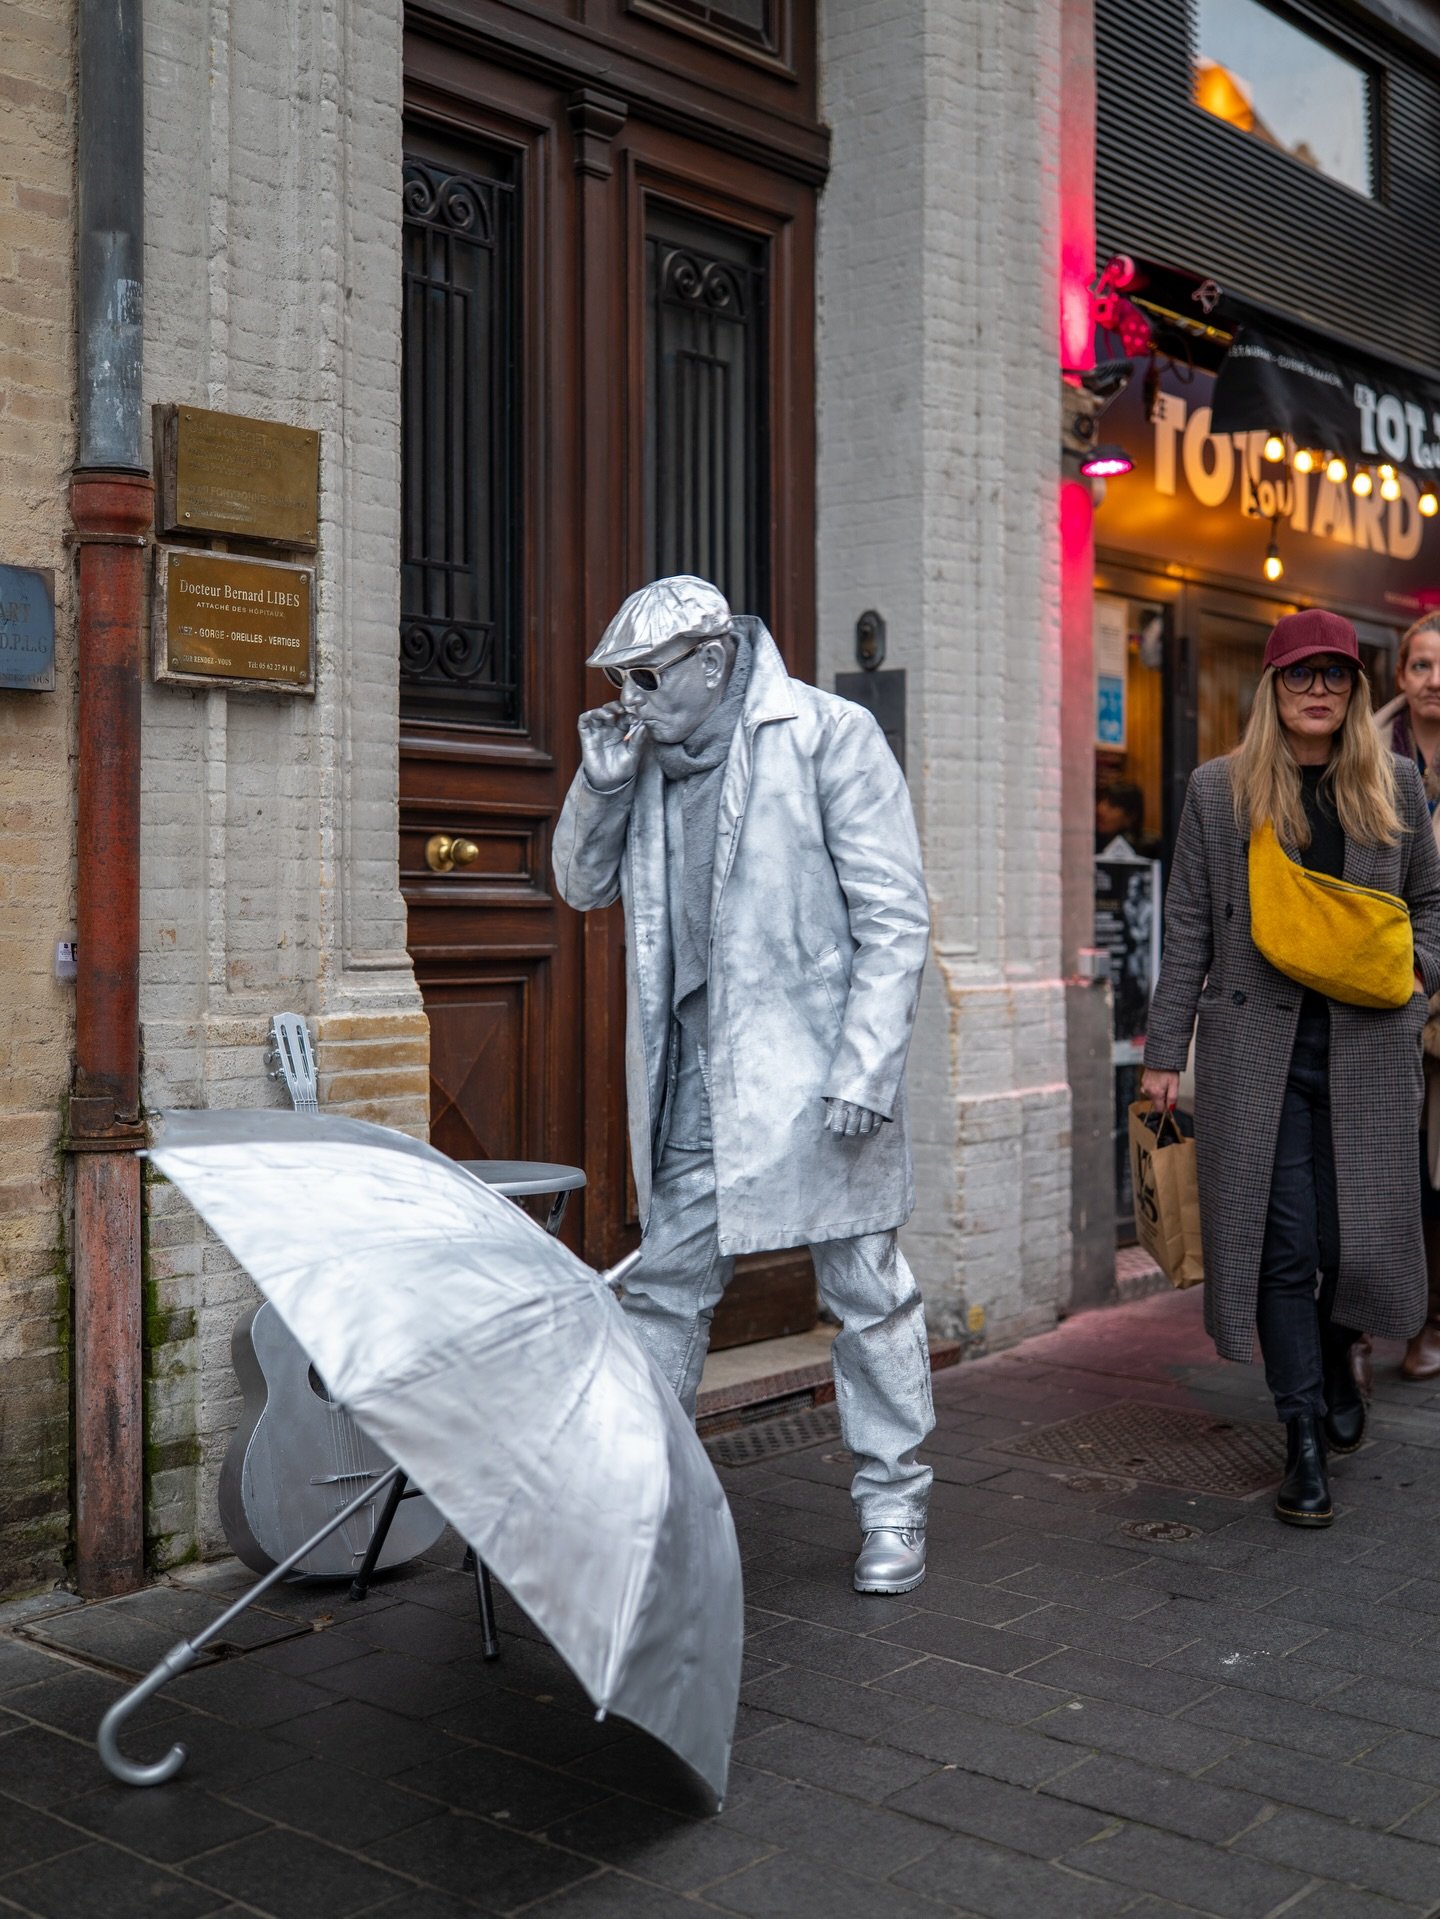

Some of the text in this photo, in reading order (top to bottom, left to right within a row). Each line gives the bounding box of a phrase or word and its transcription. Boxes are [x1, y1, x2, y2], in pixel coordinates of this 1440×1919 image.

[180, 579, 300, 607] Docteur Bernard LIBES
[196, 601, 230, 612] ATTACHÉ
[199, 628, 224, 639] GORGE
[231, 632, 262, 644] OREILLES
[269, 636, 300, 648] VERTIGES
